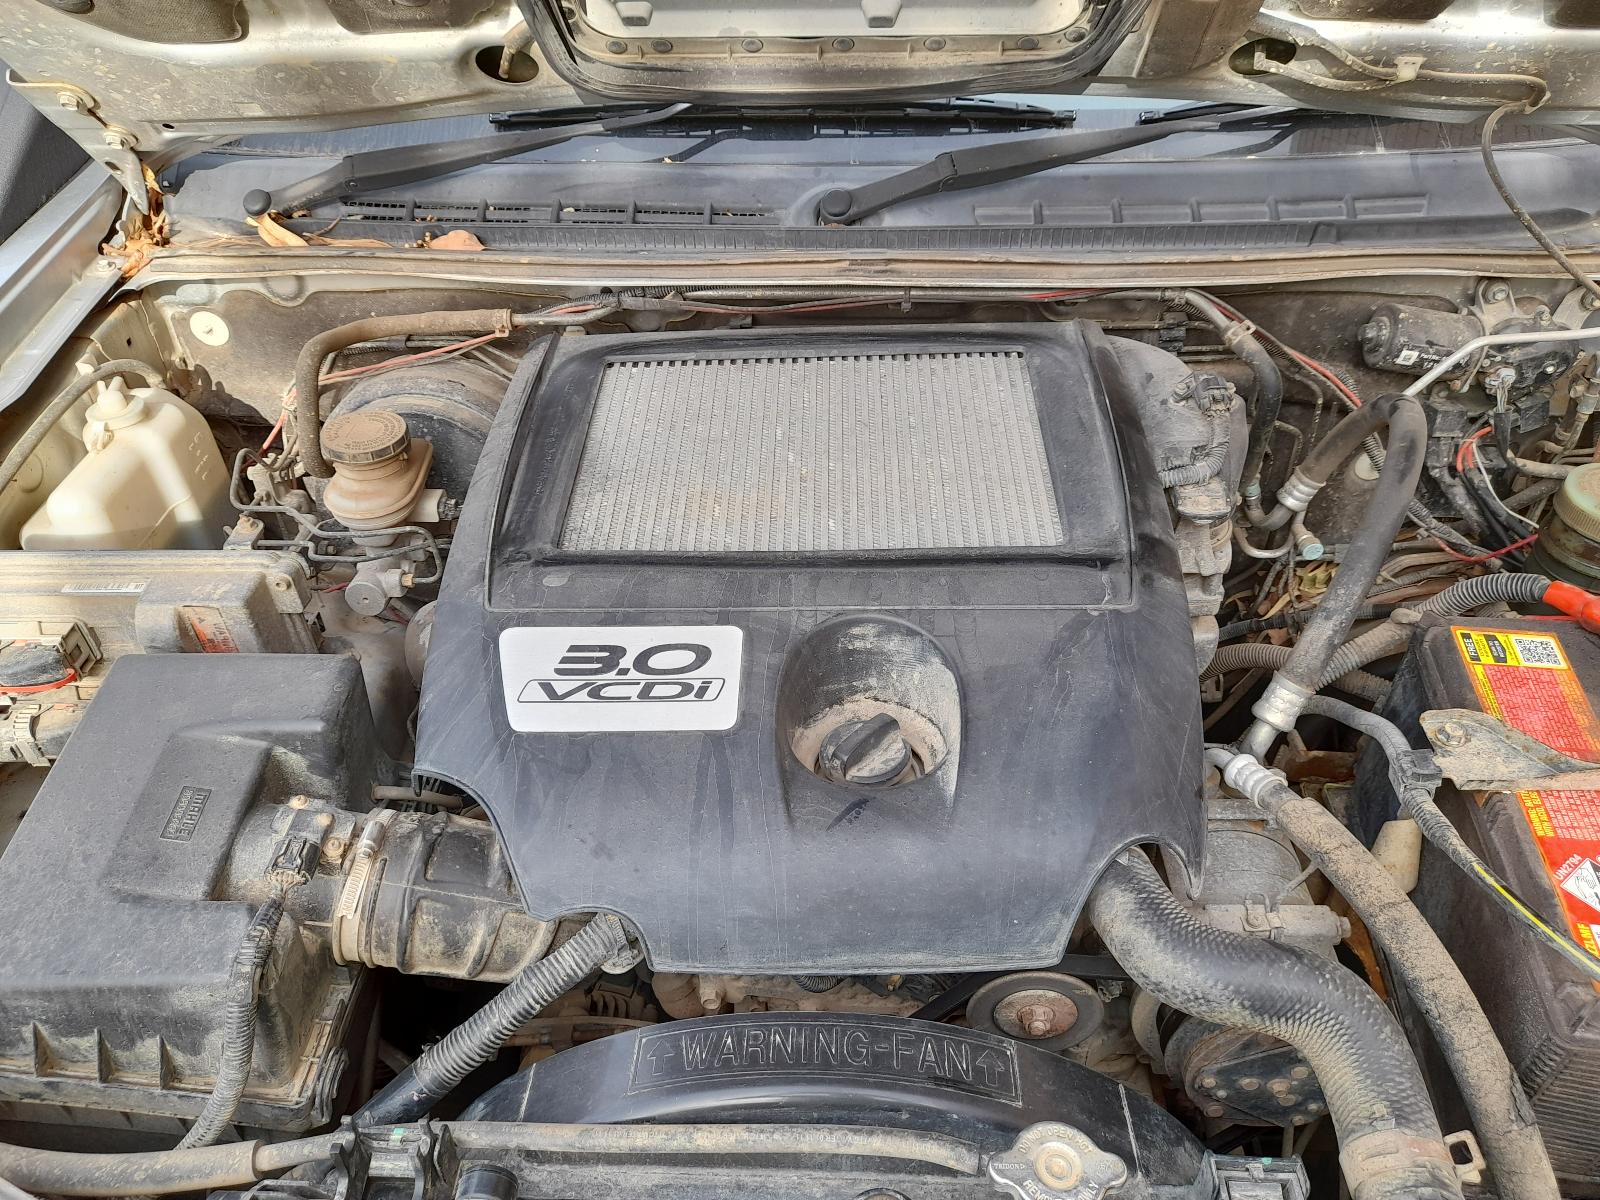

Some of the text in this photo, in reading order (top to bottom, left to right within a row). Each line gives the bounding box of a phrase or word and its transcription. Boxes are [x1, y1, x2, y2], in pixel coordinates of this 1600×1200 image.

[1463, 638, 1478, 656] FREE
[554, 643, 712, 676] 3.0
[537, 681, 713, 700] VCDi
[1553, 853, 1583, 881] UN2794
[1047, 1126, 1074, 1140] OPEN
